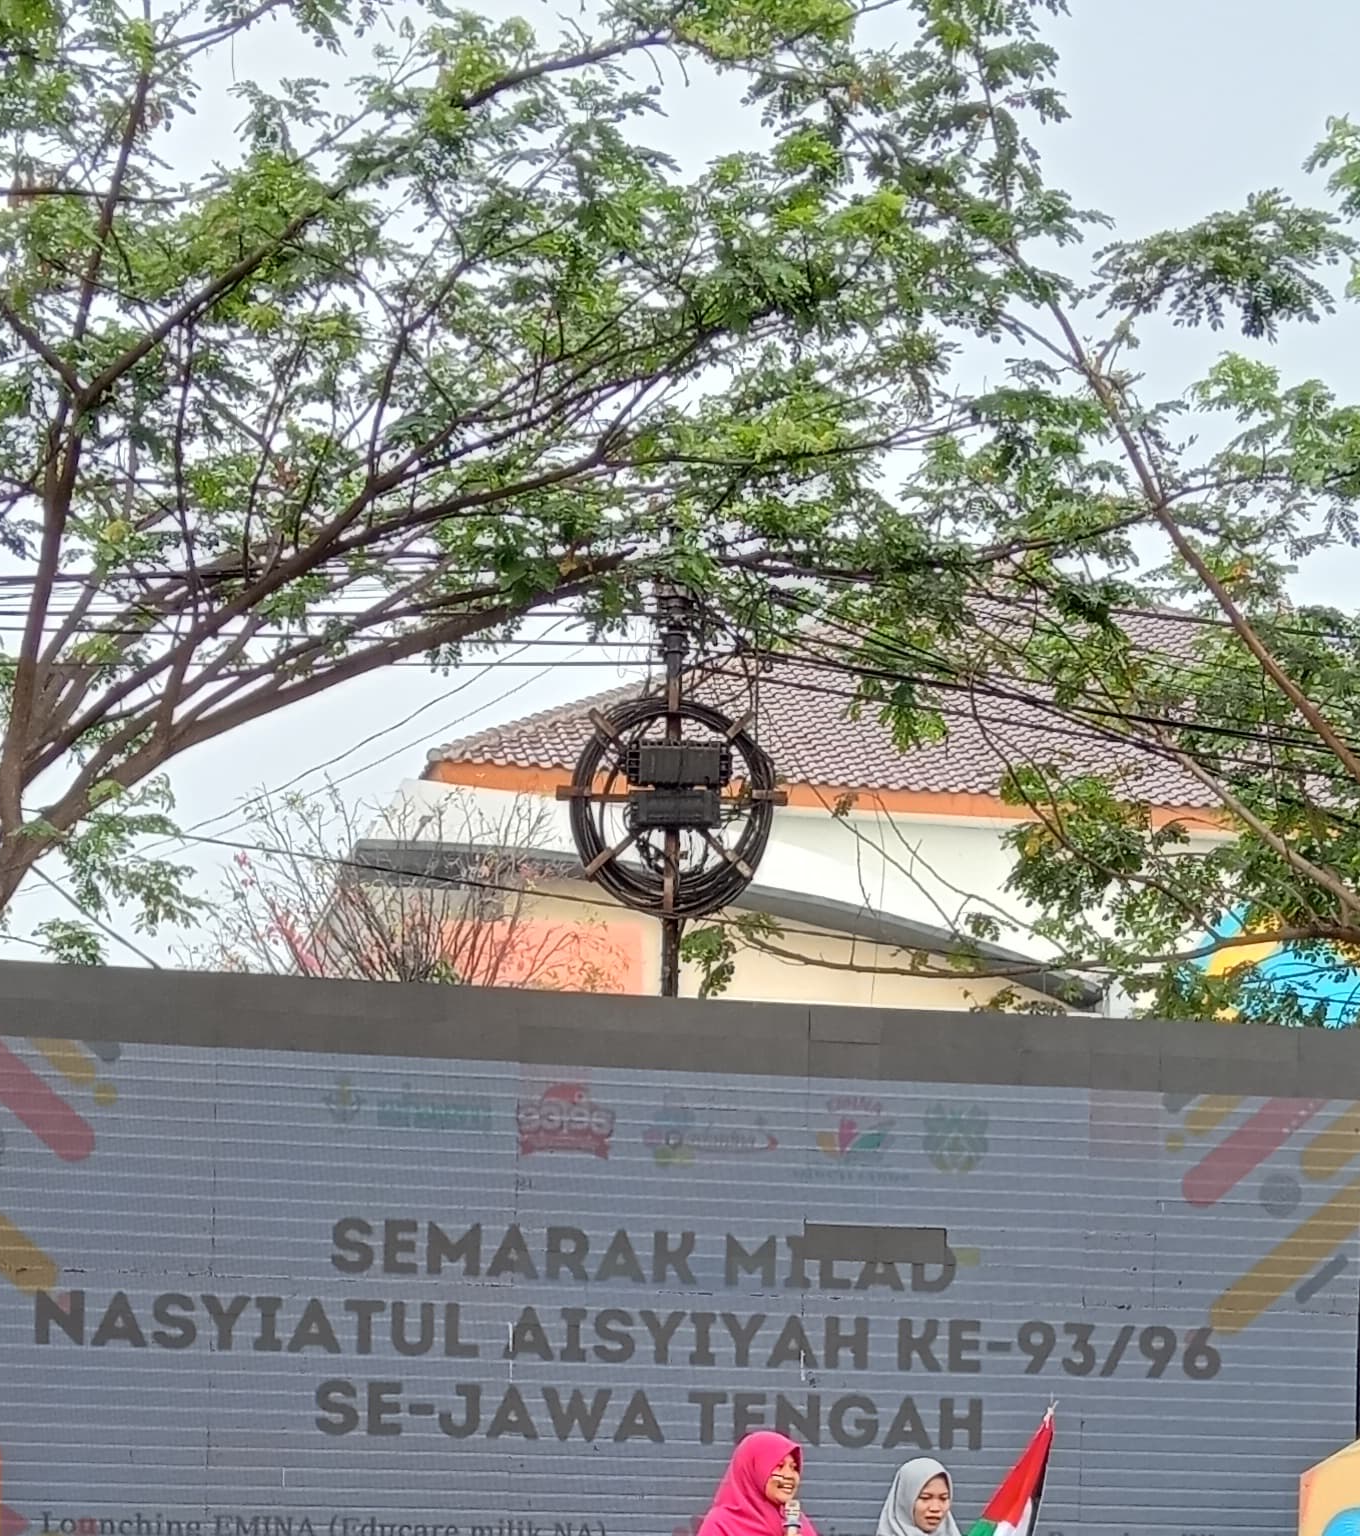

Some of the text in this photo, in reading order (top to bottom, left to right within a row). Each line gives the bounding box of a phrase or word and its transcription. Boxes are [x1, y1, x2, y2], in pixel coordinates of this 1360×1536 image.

[331, 1217, 696, 1284] SEMARAK
[34, 1287, 1222, 1381] NASYIATUL AISYIYAH KE-93/96
[314, 1379, 983, 1451] SE-JAWA TENGAH
